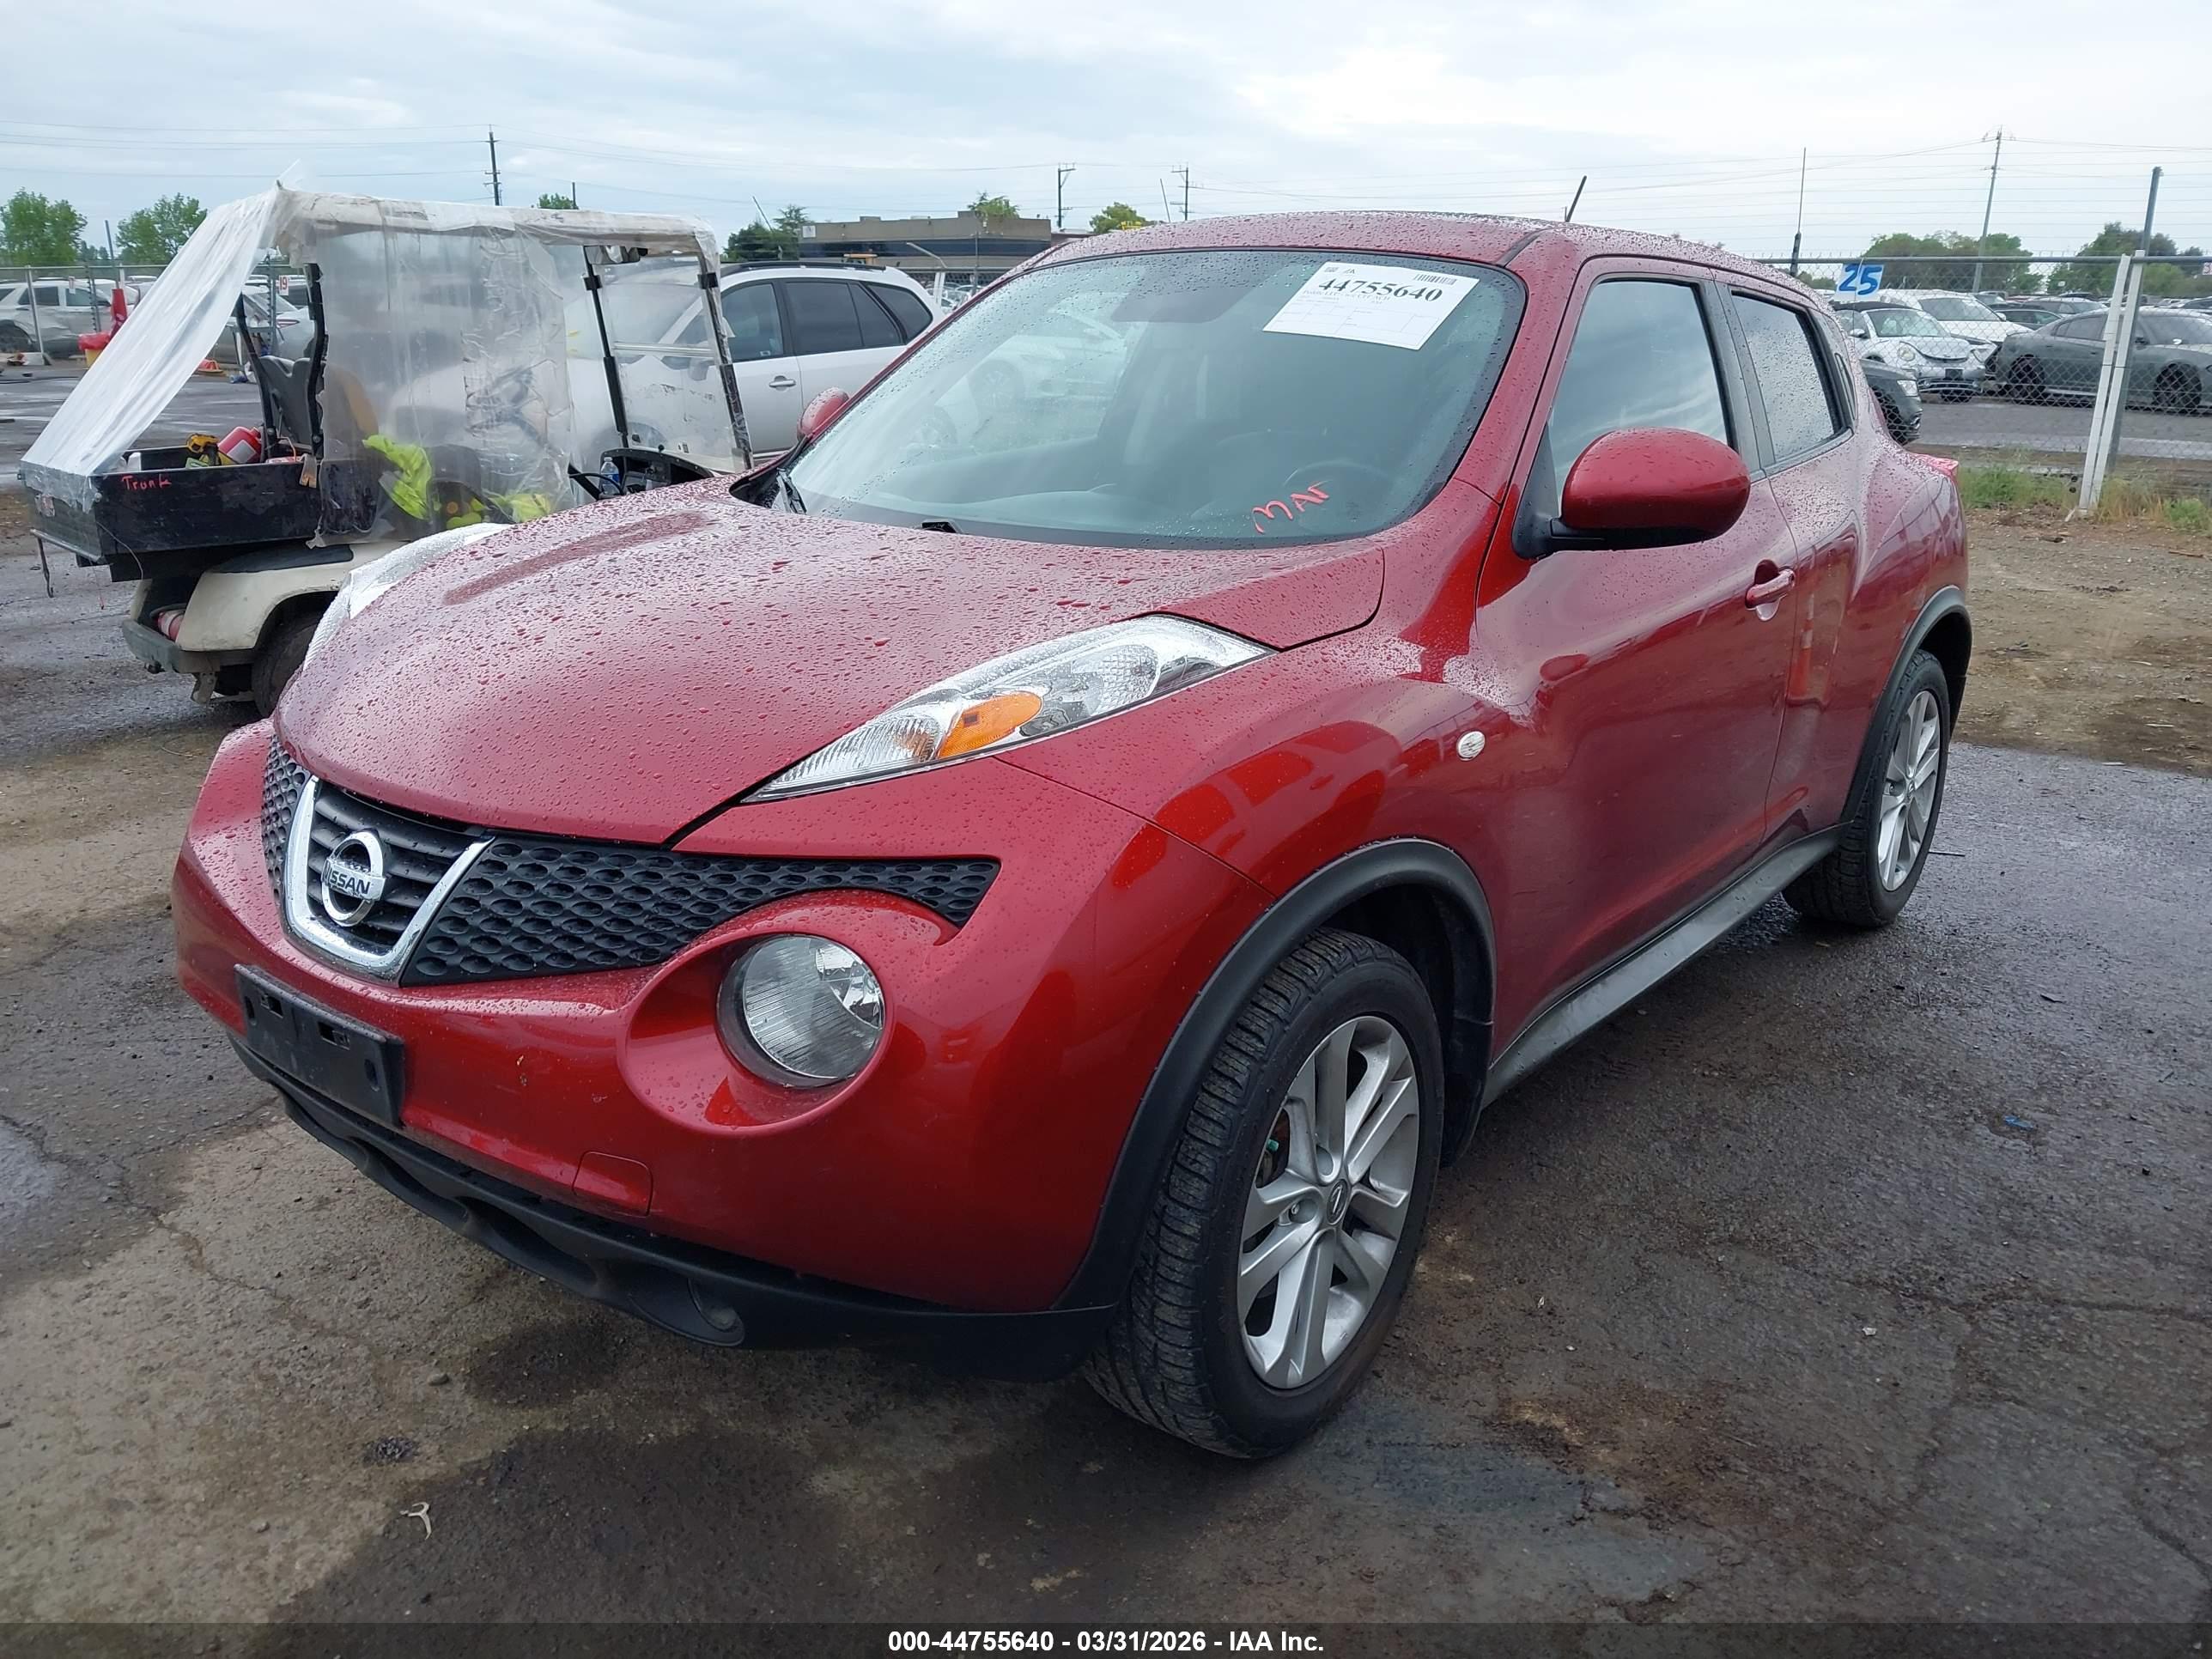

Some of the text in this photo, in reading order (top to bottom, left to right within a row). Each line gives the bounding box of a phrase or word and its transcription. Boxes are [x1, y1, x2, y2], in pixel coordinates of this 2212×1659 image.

[279, 276, 288, 290] 19
[1319, 278, 1443, 302] 44755640
[1838, 263, 1882, 295] 25
